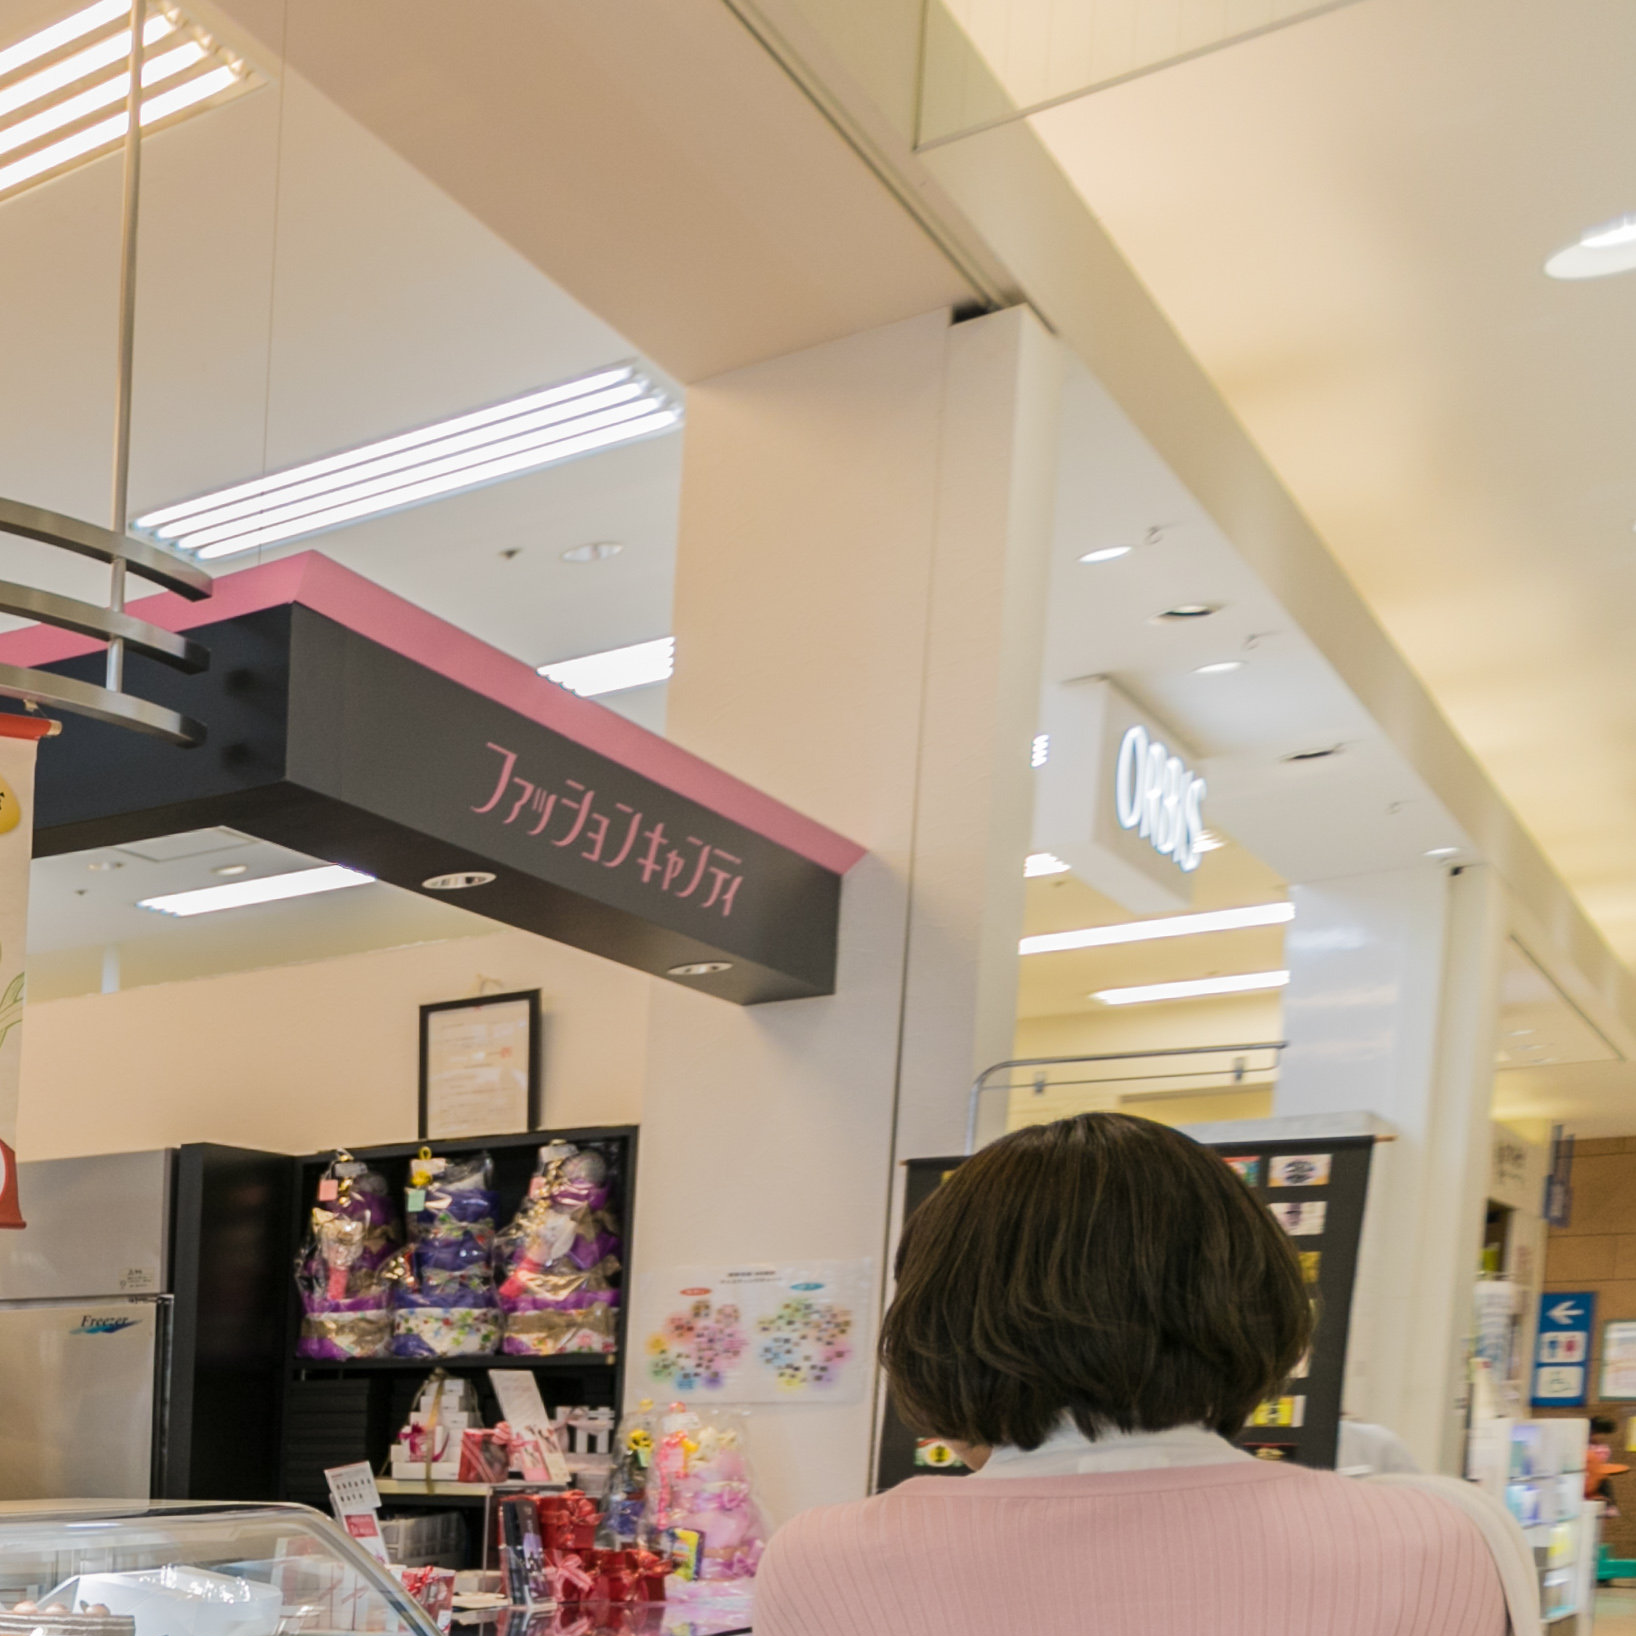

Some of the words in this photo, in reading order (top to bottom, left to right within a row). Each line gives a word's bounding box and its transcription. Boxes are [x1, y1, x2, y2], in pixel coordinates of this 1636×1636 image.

[470, 740, 744, 917] ファッションキャンディ
[1115, 723, 1208, 873] ORBIS
[80, 1315, 129, 1328] Freezer
